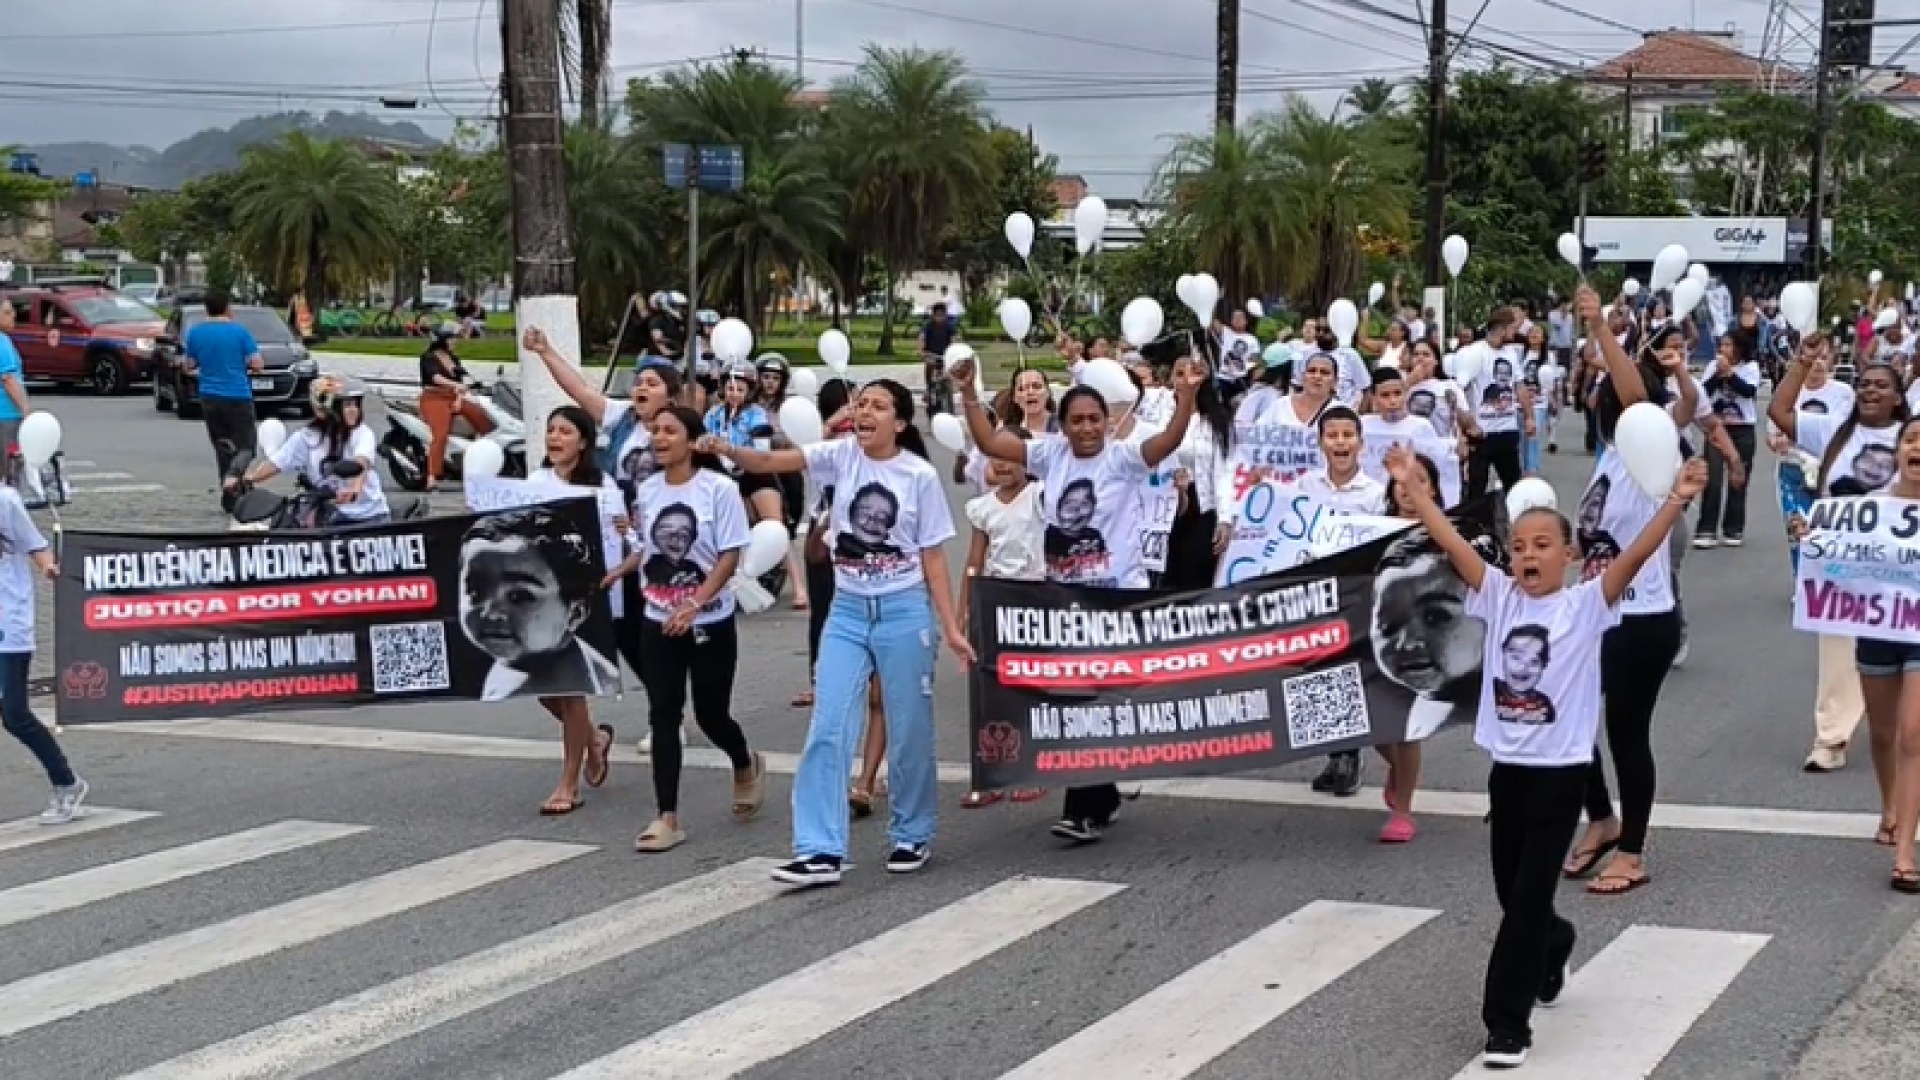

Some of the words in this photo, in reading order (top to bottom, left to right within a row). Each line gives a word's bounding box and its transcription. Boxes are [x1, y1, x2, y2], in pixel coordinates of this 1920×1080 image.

[84, 543, 236, 591] NEGLIGÊNCIA
[239, 537, 330, 582] MÉDICA
[349, 532, 428, 574] CRIME!
[93, 597, 229, 620] JUSTIÇA
[237, 592, 302, 611] POR
[309, 583, 428, 606] YOHAN!
[996, 602, 1141, 648] NEGLIGÊNCIA
[1141, 603, 1237, 644] MÉDICA
[1238, 594, 1256, 629] É
[1257, 575, 1340, 626] CRIME!
[119, 640, 151, 677] NÃO
[154, 642, 206, 675] SOMOS
[207, 635, 228, 672] SÓ
[229, 637, 268, 671] MAIS
[270, 635, 294, 668] UM
[294, 628, 358, 666] NÚMERO!
[1005, 659, 1134, 680] JUSTIÇA
[1141, 652, 1211, 674] POR
[1219, 627, 1341, 664] YOHAN!
[123, 672, 359, 705] #JUSTIÇAPORYOHAN
[1030, 702, 1062, 740] NÃO
[1062, 704, 1114, 740] SOMOS
[1114, 697, 1137, 736] SÓ
[1137, 701, 1178, 735] MAIS
[1178, 698, 1204, 731] UM
[1204, 688, 1271, 728] NÚMERO!
[1036, 730, 1274, 770] #JUSTIÇAPORYOHAN
